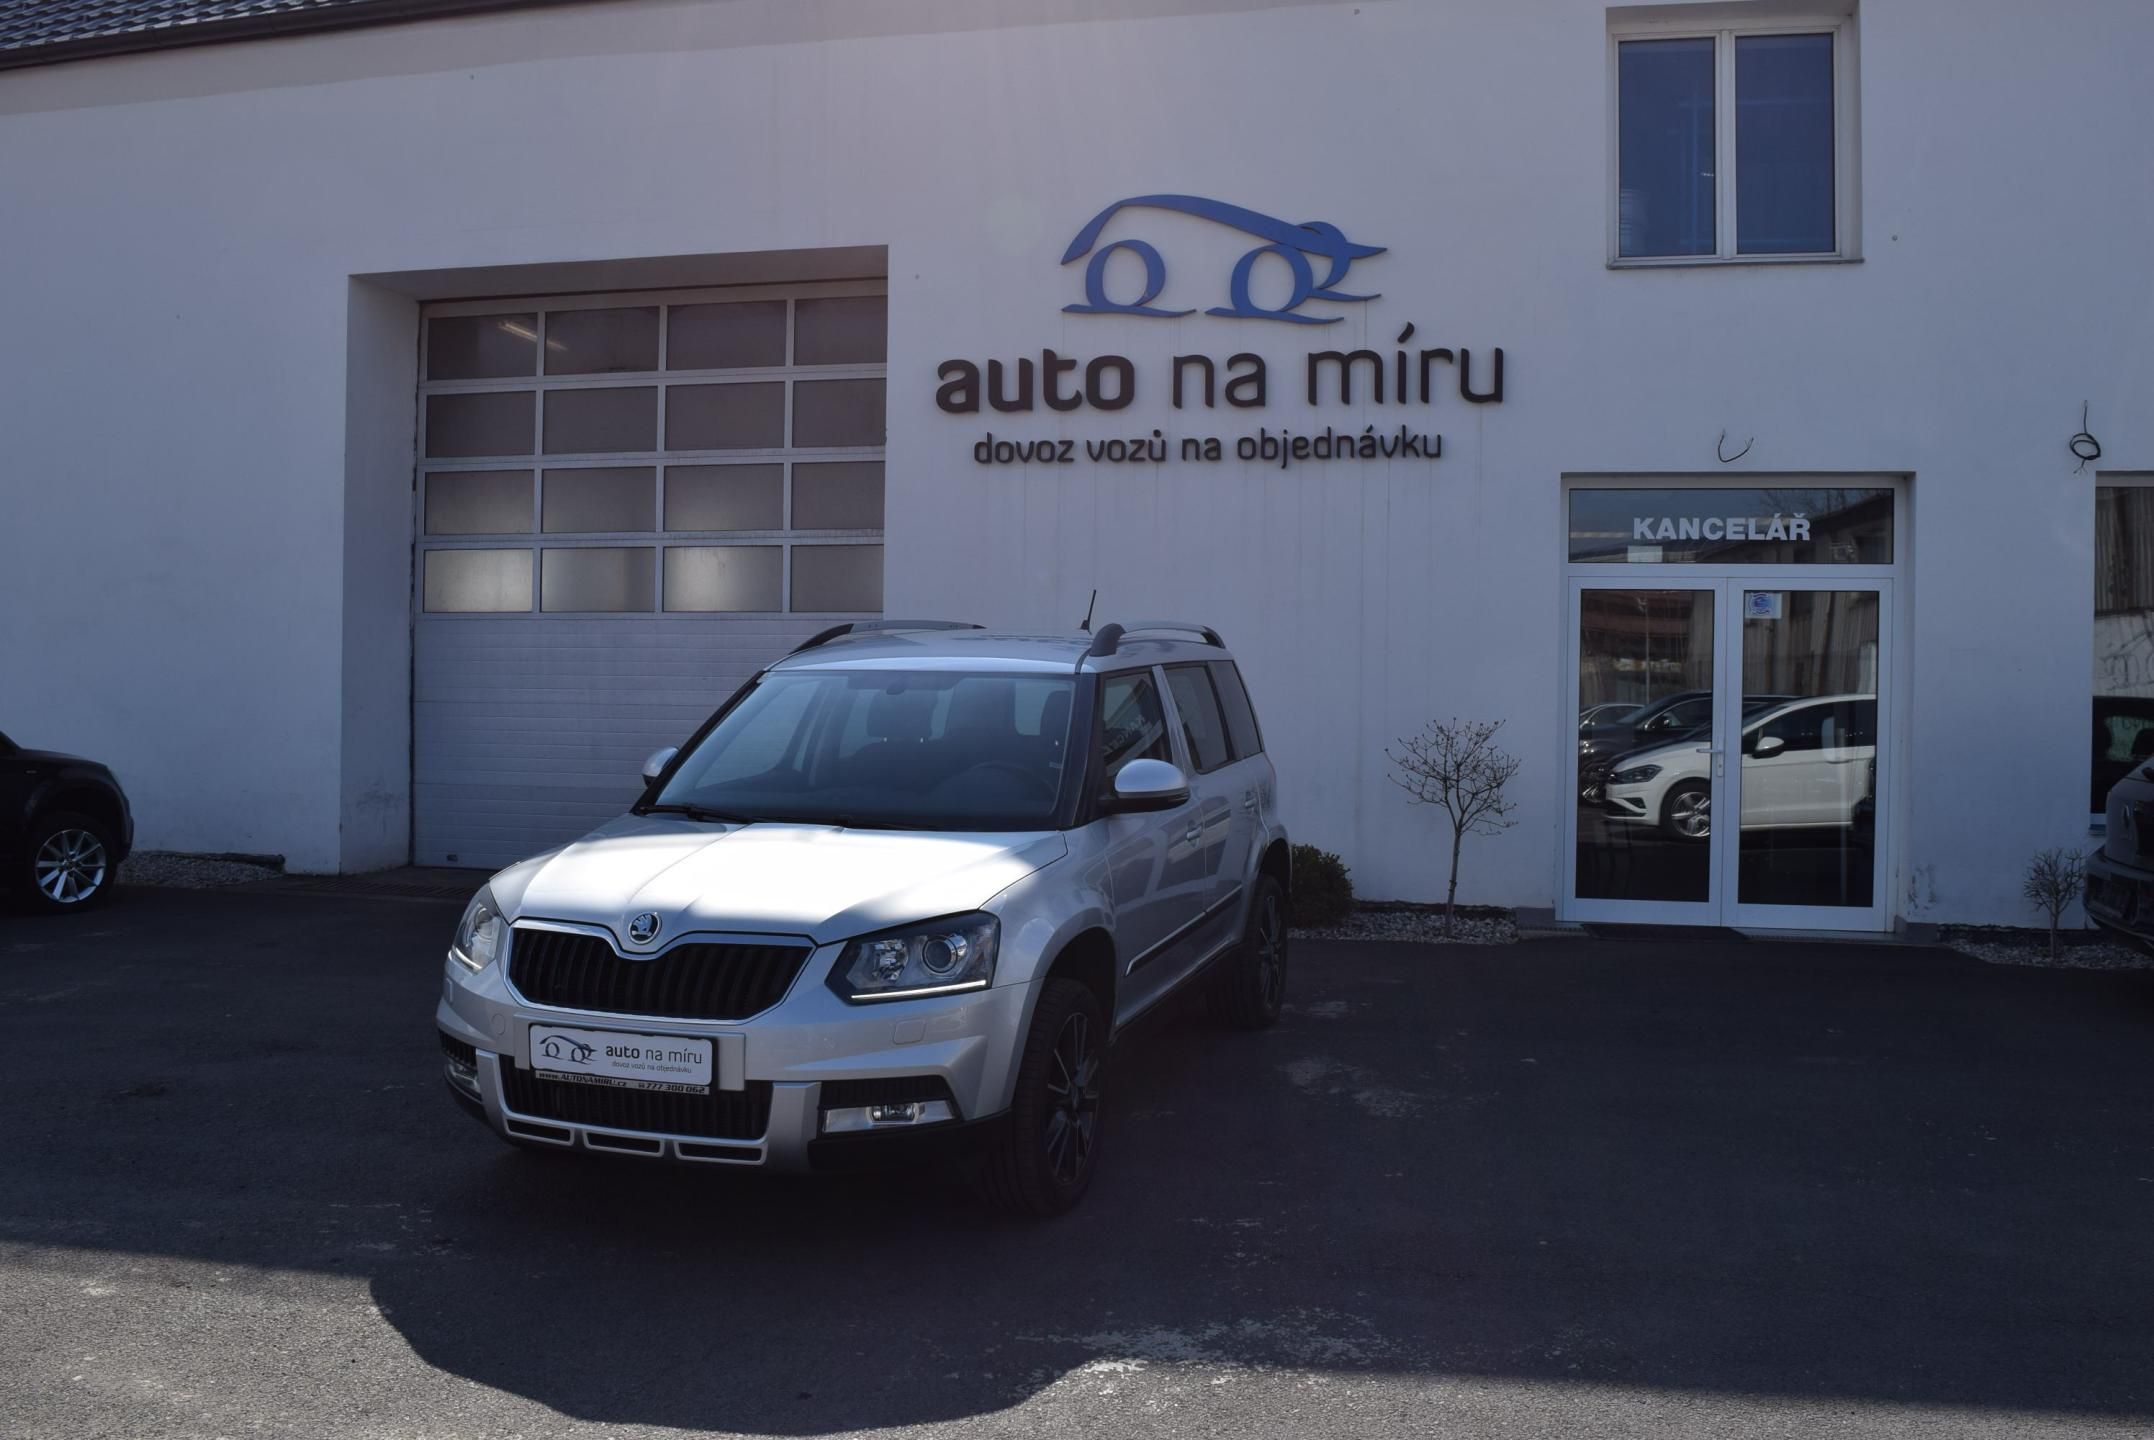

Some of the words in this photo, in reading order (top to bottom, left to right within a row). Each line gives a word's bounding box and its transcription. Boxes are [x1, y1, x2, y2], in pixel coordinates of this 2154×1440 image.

[935, 348, 1136, 414] auto
[1173, 351, 1266, 409] na
[1307, 322, 1504, 406] míru
[974, 432, 1075, 465] dovoz
[1087, 429, 1167, 463] vozů
[1181, 440, 1222, 461] na
[1237, 425, 1442, 469] objednávku
[1633, 512, 1811, 541] KANCELÁŘ
[605, 1044, 641, 1060] auto
[645, 1049, 663, 1062] na
[668, 1048, 703, 1065] míru
[647, 1063, 656, 1071] na
[665, 1084, 684, 1092] 300
[685, 1086, 706, 1094] 062
